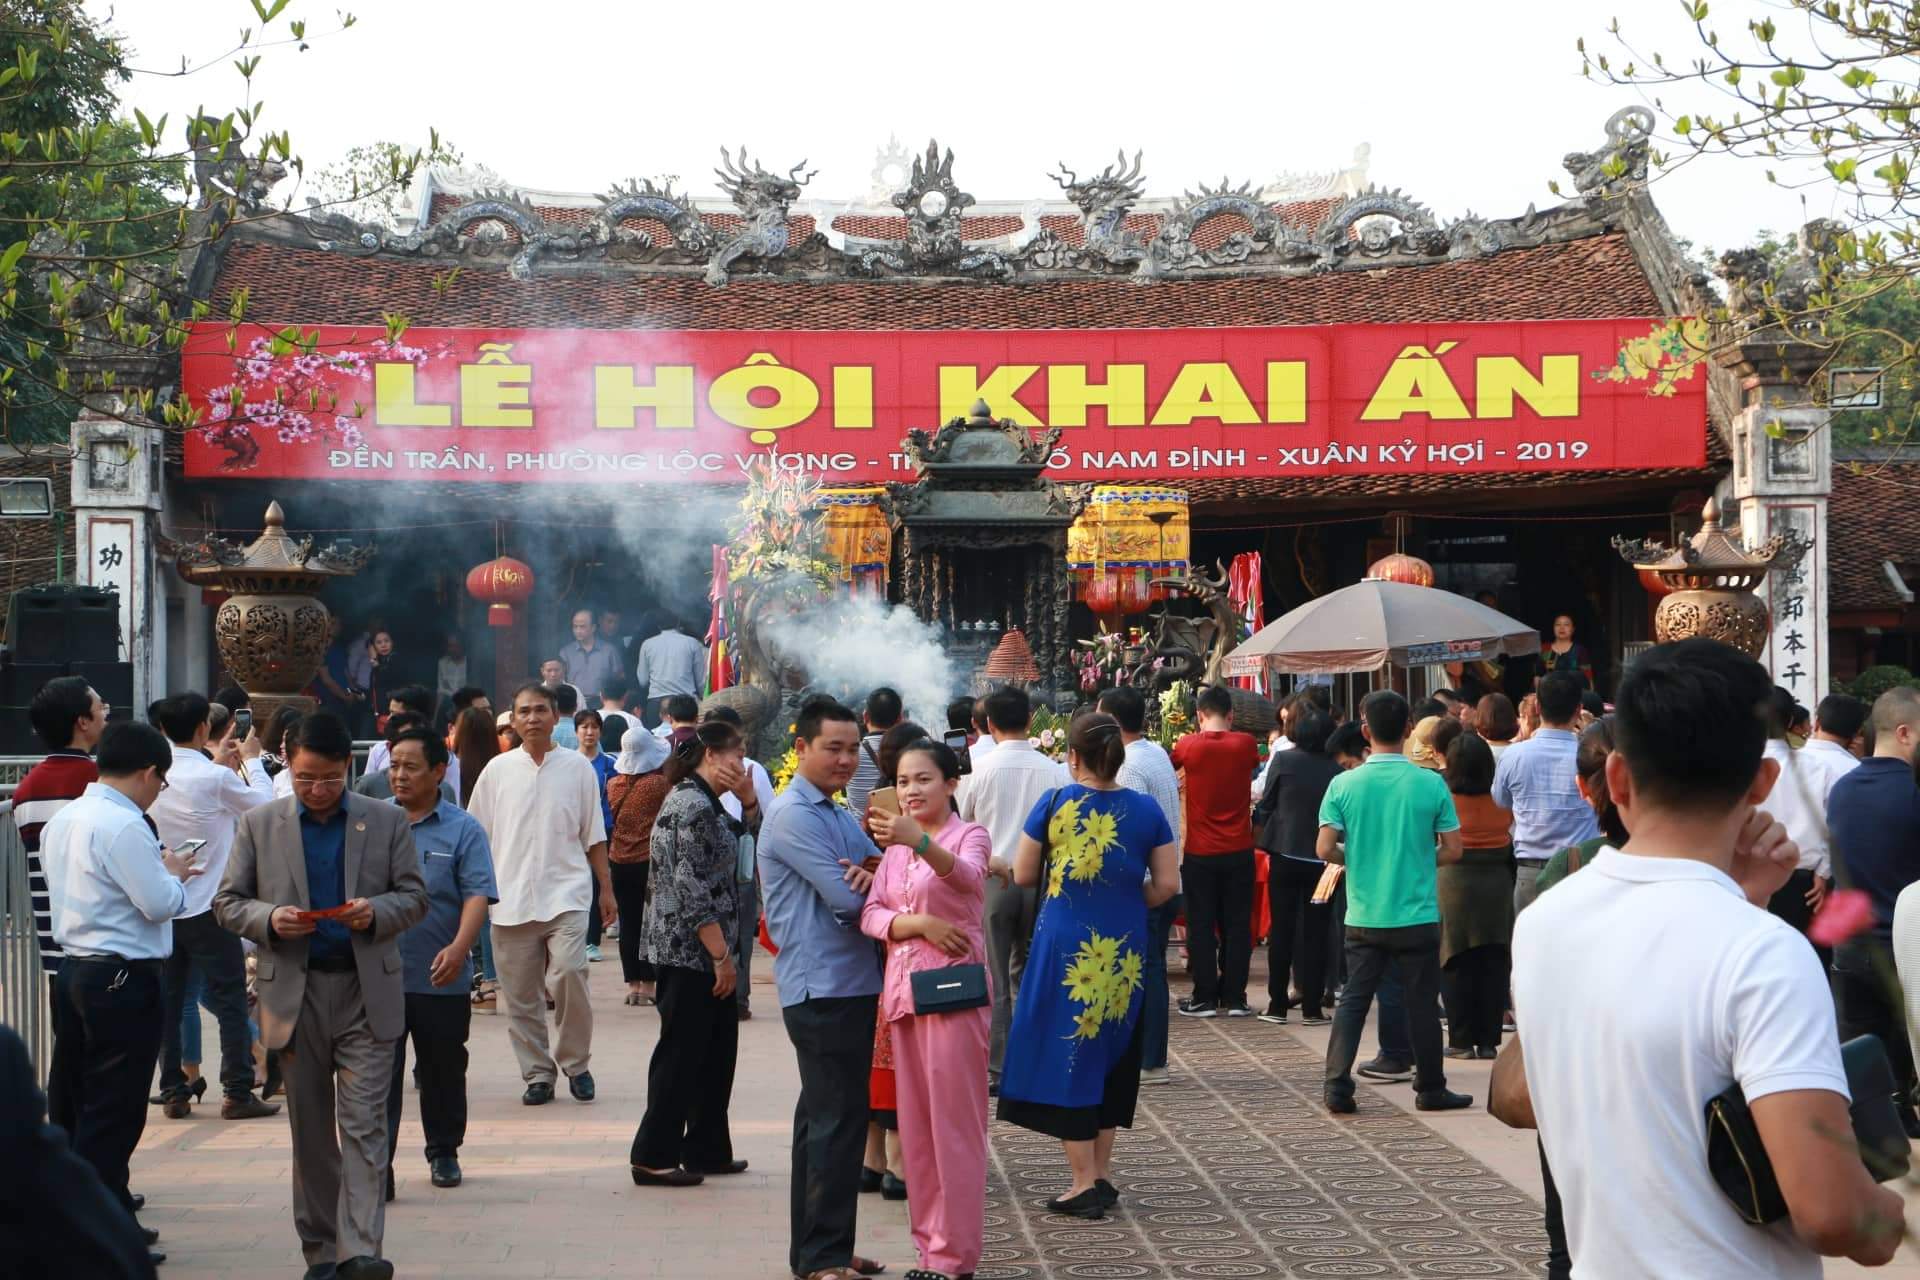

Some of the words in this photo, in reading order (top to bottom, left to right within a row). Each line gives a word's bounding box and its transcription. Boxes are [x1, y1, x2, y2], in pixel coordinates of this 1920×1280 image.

[375, 342, 534, 426] LỄ
[595, 352, 873, 444] HỘI
[939, 360, 1307, 428] KHAI
[1360, 341, 1580, 421] ẤN
[328, 443, 393, 468] ĐỀN
[404, 445, 496, 473] TRẦN,
[506, 449, 648, 471] PHƯỜNG
[658, 449, 724, 475] LỘC
[1082, 451, 1157, 469] NAM
[1167, 446, 1245, 471] ĐỊNH
[1278, 441, 1368, 466] XUÂN
[1379, 438, 1418, 462] KỶ
[1516, 441, 1589, 460] 2019
